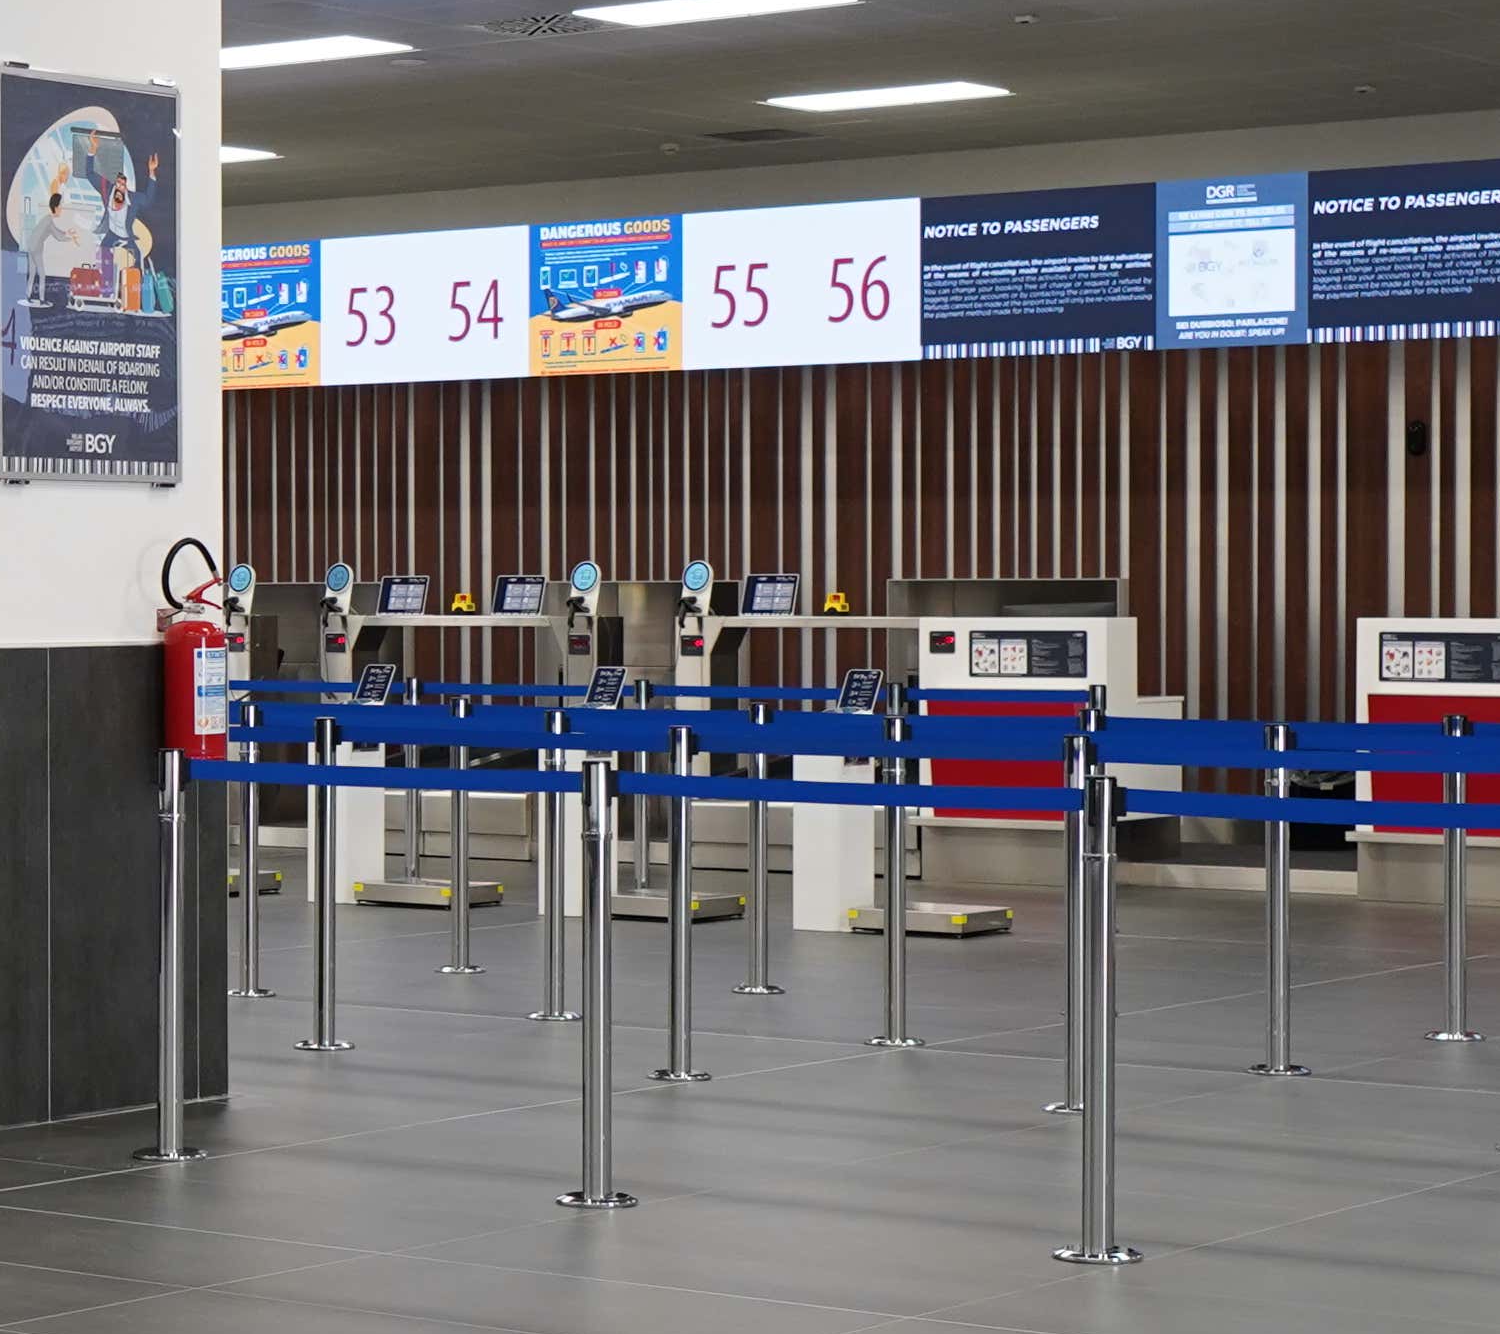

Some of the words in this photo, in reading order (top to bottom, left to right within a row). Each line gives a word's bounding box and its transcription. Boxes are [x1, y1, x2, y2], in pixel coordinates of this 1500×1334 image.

[1206, 185, 1235, 198] DGR
[1313, 197, 1375, 215] NOTICE
[1378, 195, 1401, 211] TO
[539, 222, 621, 241] DANGEROUS
[623, 219, 671, 235] GOODS
[924, 223, 977, 238] NOTICE
[981, 222, 1001, 235] TO
[1004, 215, 1099, 234] PASSENGERS
[222, 246, 267, 262] GEROUS
[269, 244, 310, 258] GOODS
[711, 263, 768, 328] 55
[828, 255, 890, 323] 56
[346, 286, 396, 347] 53
[448, 279, 503, 342] 54
[20, 336, 62, 353] VIOLENCE
[62, 339, 99, 355] AGAINST
[99, 341, 136, 357] AIRPORT
[136, 344, 160, 359] STAFF
[1116, 336, 1142, 349] BGY
[20, 355, 38, 370] CAN
[39, 356, 67, 372] RESULT
[67, 358, 77, 372] IN
[106, 361, 118, 375] OF
[118, 361, 160, 377] BOARDING
[32, 375, 65, 390] AND/OR
[65, 376, 111, 393] CONSTITUTE
[112, 379, 118, 392] A
[30, 393, 67, 408] RESPECT
[85, 433, 116, 454] BGY
